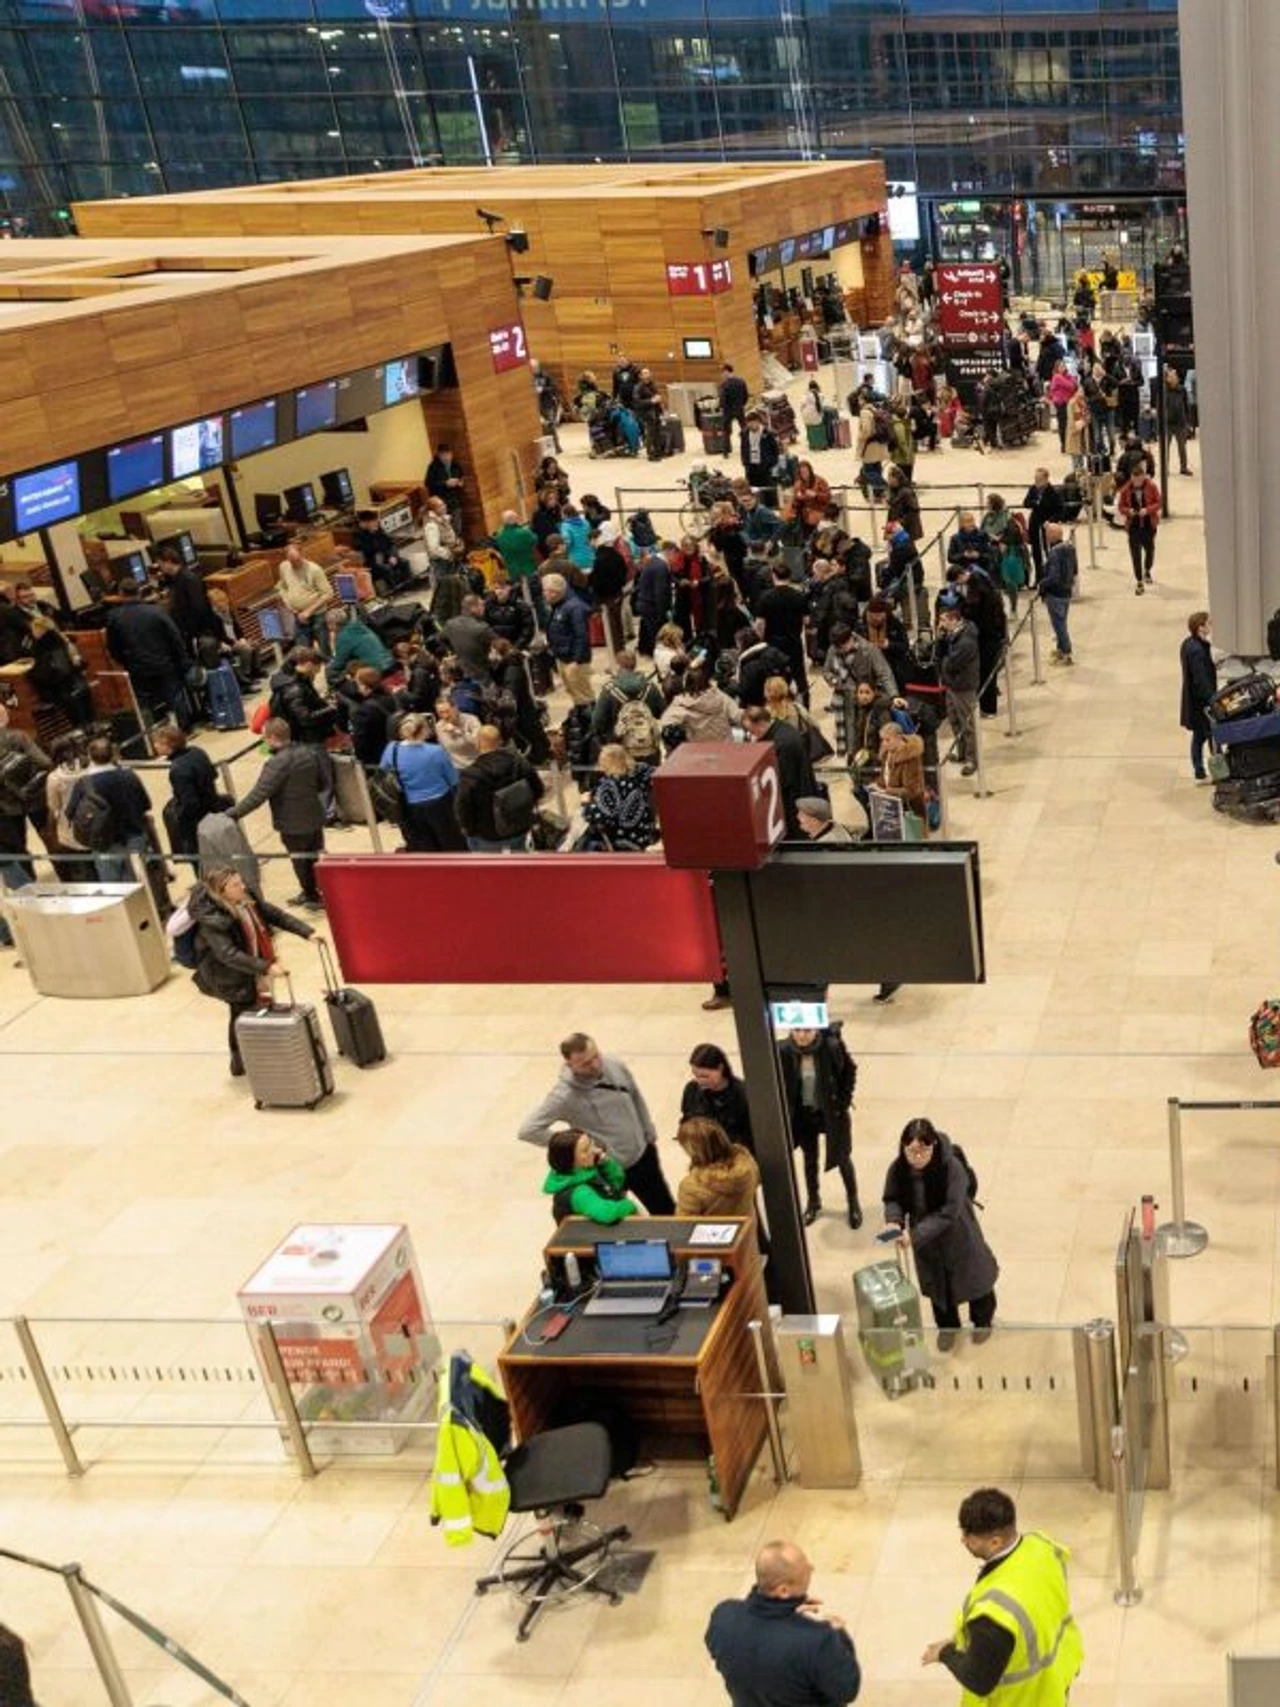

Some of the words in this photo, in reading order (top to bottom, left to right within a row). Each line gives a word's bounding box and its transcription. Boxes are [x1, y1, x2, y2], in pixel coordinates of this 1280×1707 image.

[693, 265, 706, 290] 1
[512, 326, 526, 358] 2
[761, 766, 785, 845] 2
[248, 1304, 277, 1317] BER
[278, 1346, 320, 1356] PENDE
